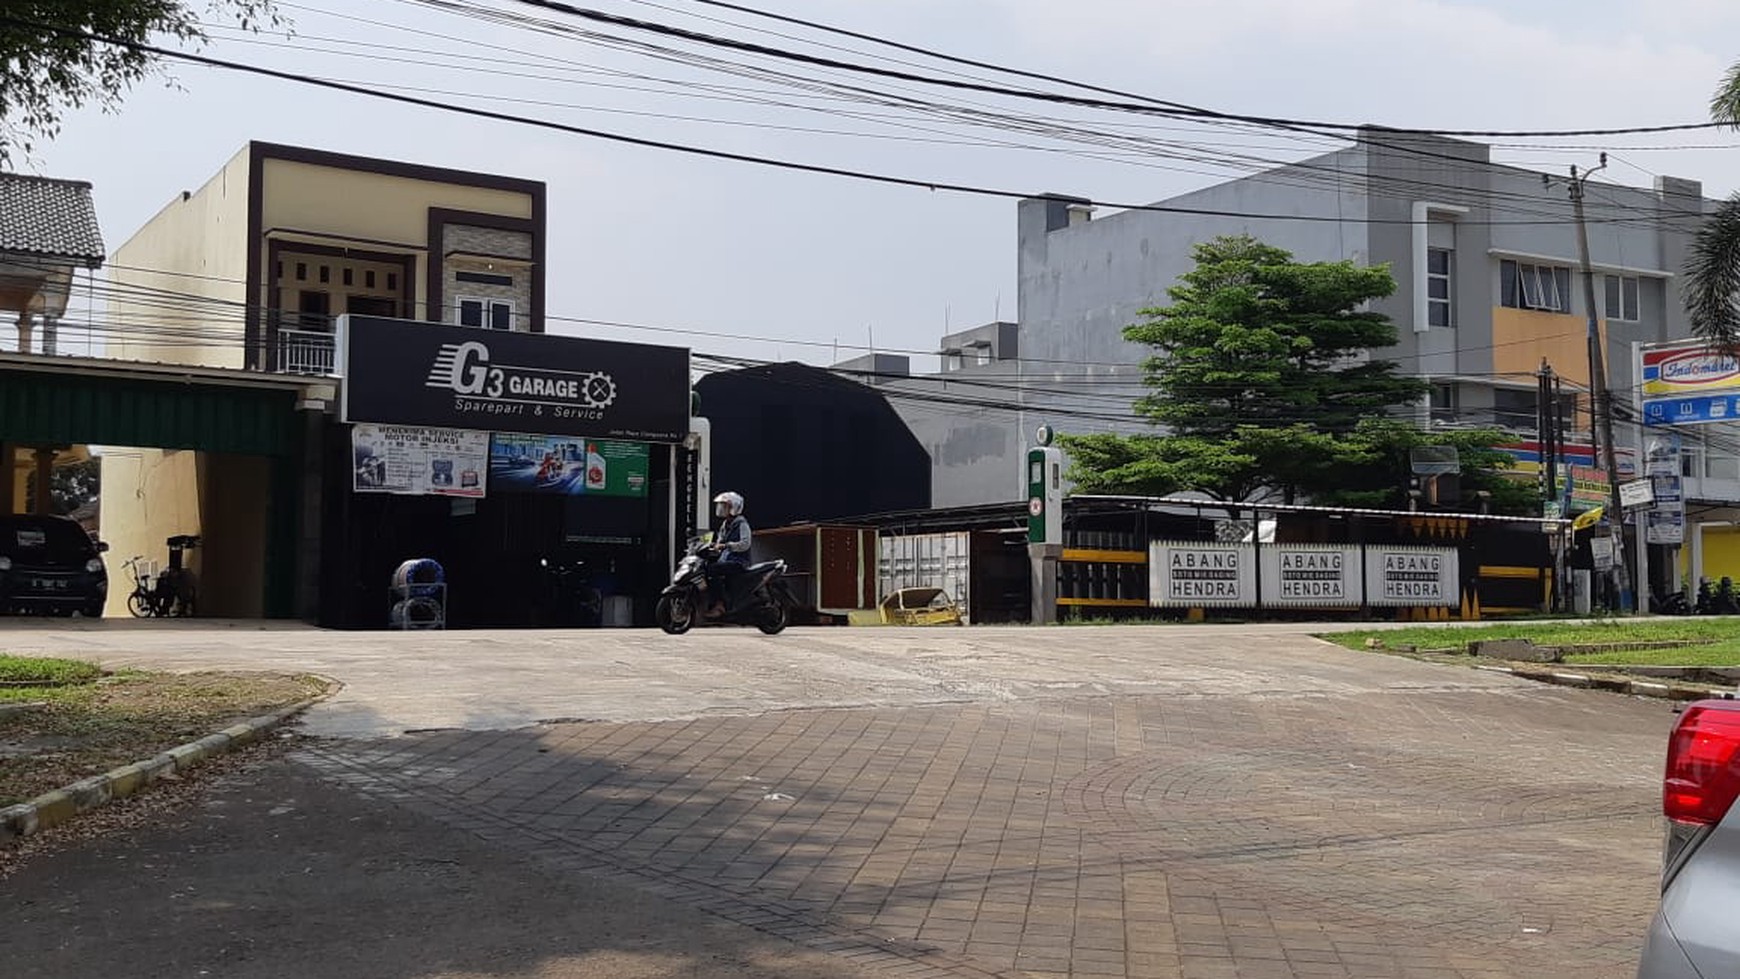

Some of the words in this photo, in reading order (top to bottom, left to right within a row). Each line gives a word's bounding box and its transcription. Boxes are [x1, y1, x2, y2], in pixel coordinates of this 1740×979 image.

[509, 376, 579, 398] GARAGE
[454, 399, 524, 416] Sparepart
[533, 404, 544, 417] &
[553, 406, 604, 421] Service
[378, 426, 425, 436] MENERIMA
[428, 428, 464, 438] SERVICE
[421, 435, 459, 445] INJEKSI
[1172, 553, 1237, 568] ABANG
[1283, 555, 1341, 569] ABANG
[1386, 556, 1439, 570] ABANG
[1172, 582, 1237, 596] HENDRA
[1283, 582, 1341, 596] HENDRA
[1386, 582, 1439, 596] HENDRA
